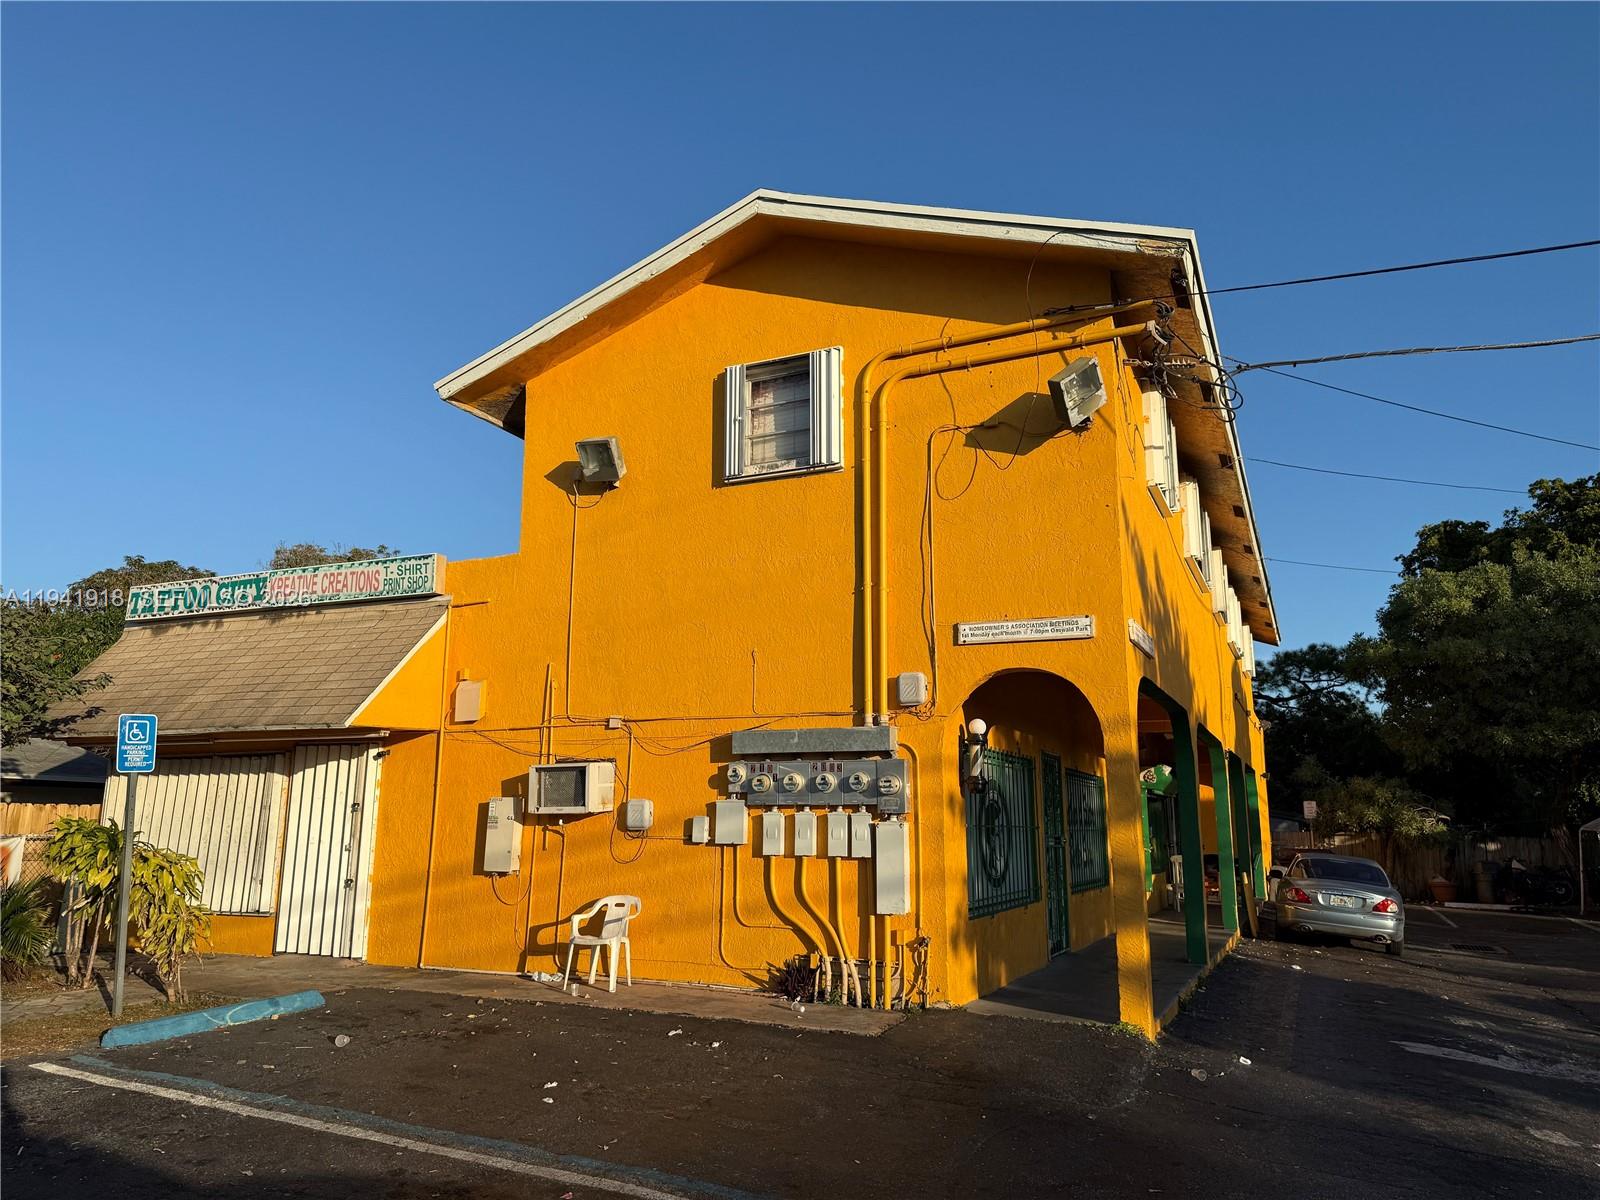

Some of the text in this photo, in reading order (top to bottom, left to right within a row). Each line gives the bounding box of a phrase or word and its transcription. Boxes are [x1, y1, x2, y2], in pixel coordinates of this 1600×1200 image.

[397, 562, 430, 576] SHIRT
[270, 569, 381, 598] KREATIVE CREATIONS
[383, 574, 429, 592] PRINT SHOP
[1011, 621, 1049, 631] ASSOCIATION
[1049, 620, 1080, 628] MEETINGS
